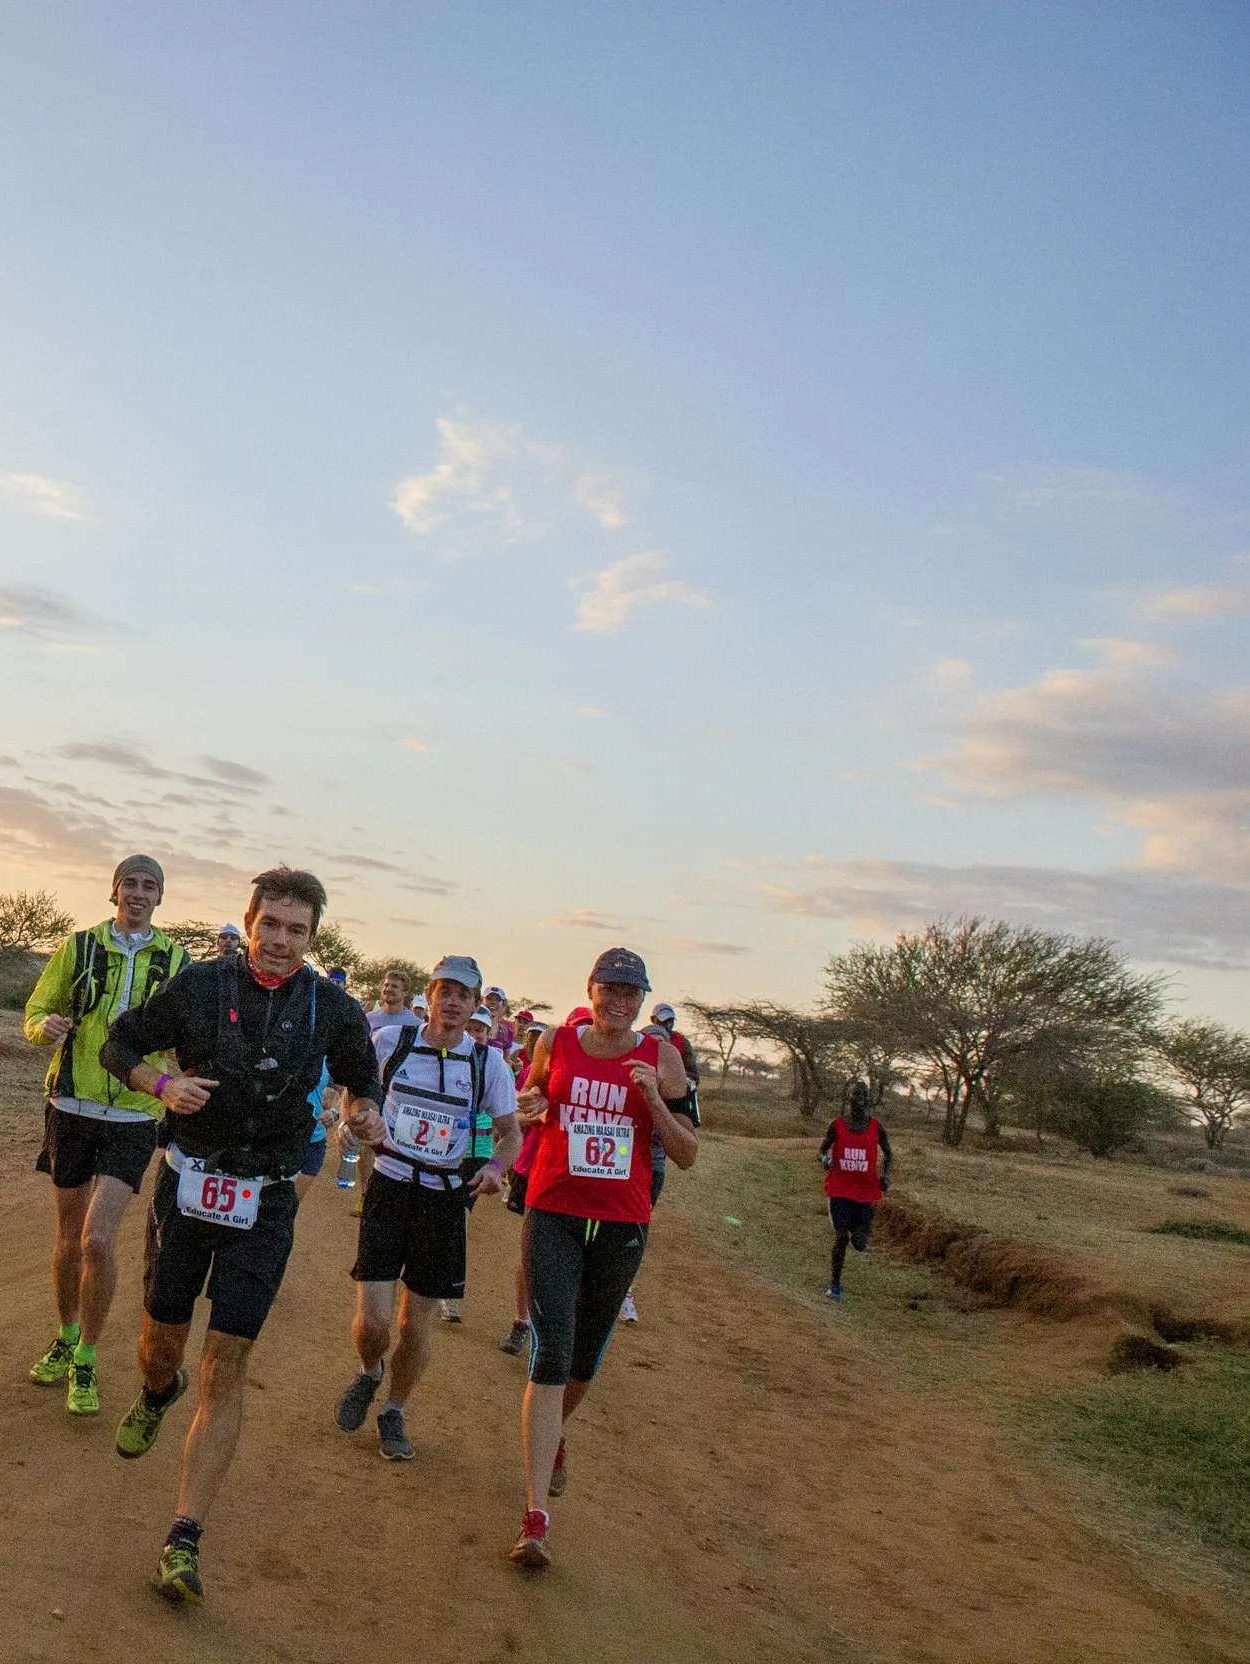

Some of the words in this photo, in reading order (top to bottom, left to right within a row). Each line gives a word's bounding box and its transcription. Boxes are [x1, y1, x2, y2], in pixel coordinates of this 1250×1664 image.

[570, 1076, 628, 1113] RUN
[414, 1119, 430, 1146] 2
[573, 1124, 595, 1136] AMAZING
[595, 1125, 615, 1137] MAASAI
[616, 1127, 630, 1138] ULTRA
[396, 1139, 423, 1152] Educate
[431, 1148, 443, 1156] Girl
[585, 1136, 616, 1168] 62
[844, 1147, 866, 1161] RUN
[573, 1165, 605, 1175] Educate
[606, 1167, 612, 1175] A
[614, 1168, 627, 1176] Girl
[840, 1159, 869, 1172] KENYA
[201, 1176, 238, 1213] 65
[186, 1206, 221, 1220] Educate
[223, 1213, 230, 1222] A
[232, 1215, 249, 1225] Girl
